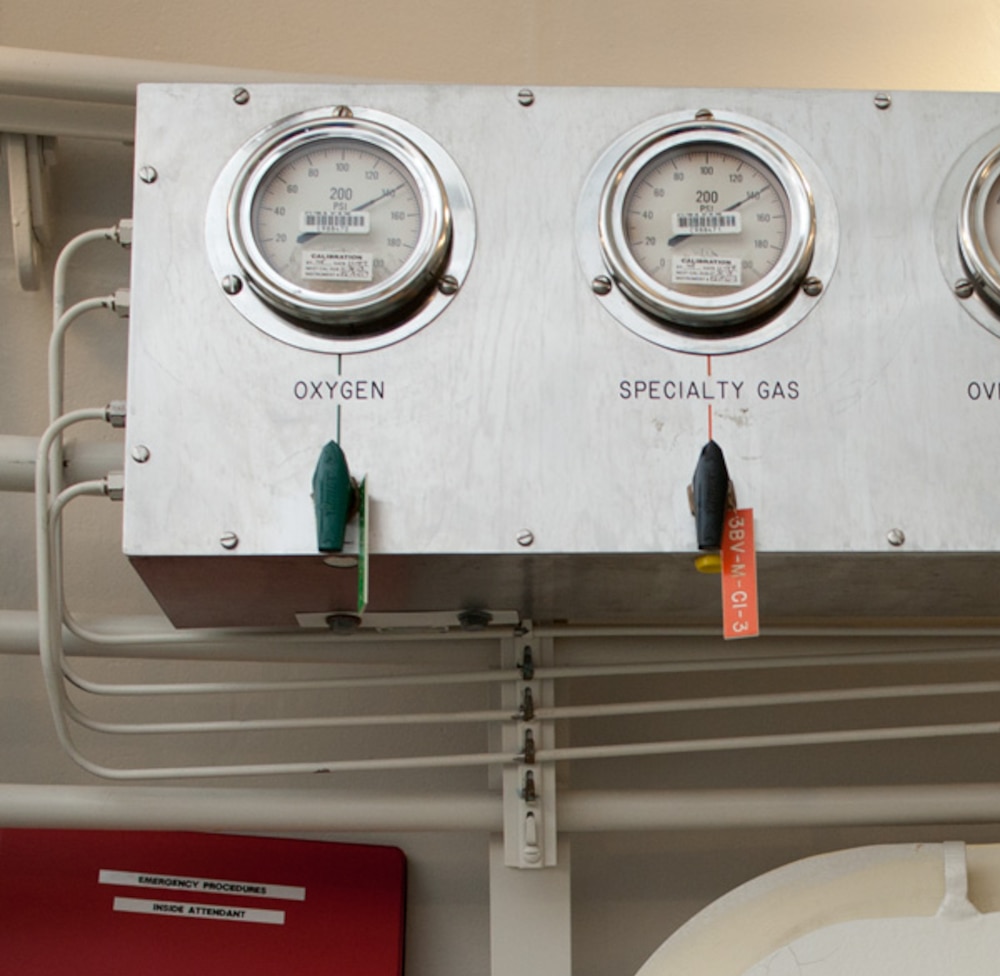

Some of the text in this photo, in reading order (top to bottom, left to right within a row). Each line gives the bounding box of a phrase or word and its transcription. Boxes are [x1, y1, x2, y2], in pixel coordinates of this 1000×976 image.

[336, 163, 349, 172] 100
[700, 166, 713, 175] 100
[308, 169, 319, 177] 80
[365, 171, 378, 180] 120
[673, 172, 684, 181] 80
[729, 174, 743, 183] 120
[287, 184, 298, 193] 60
[654, 188, 665, 197] 60
[330, 187, 352, 200] 200
[696, 190, 718, 203] 200
[333, 202, 347, 211] PSI
[274, 207, 285, 216] 40
[391, 211, 405, 220] 160
[642, 211, 653, 220] 40
[757, 213, 770, 222] 160
[275, 233, 287, 243] 20
[645, 237, 656, 246] 20
[388, 238, 401, 248] 180
[754, 239, 768, 249] 180
[294, 381, 384, 400] OXYGEN
[619, 381, 800, 400] SPECIALTY GAS
[728, 517, 749, 633] 3BV-M-CI-3
[138, 876, 267, 895] EMERGENCY PROCEDURES
[153, 904, 246, 918] INSIDE ATTENDANT
